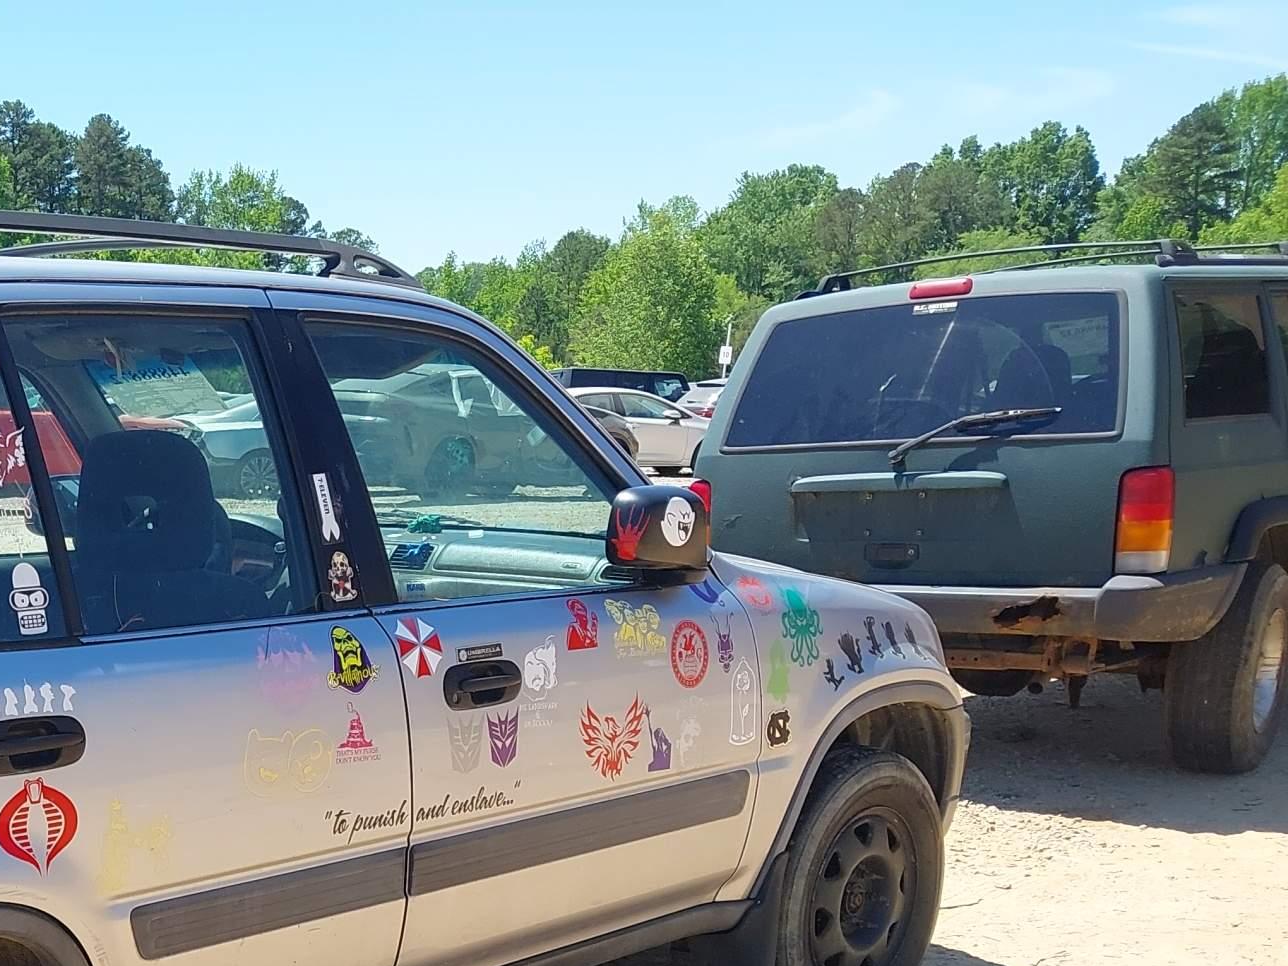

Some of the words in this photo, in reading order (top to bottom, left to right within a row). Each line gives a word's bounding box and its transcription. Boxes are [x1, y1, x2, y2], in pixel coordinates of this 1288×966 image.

[467, 646, 501, 656] UMBRELLA
[348, 800, 409, 845] punish
[415, 794, 450, 822] and
